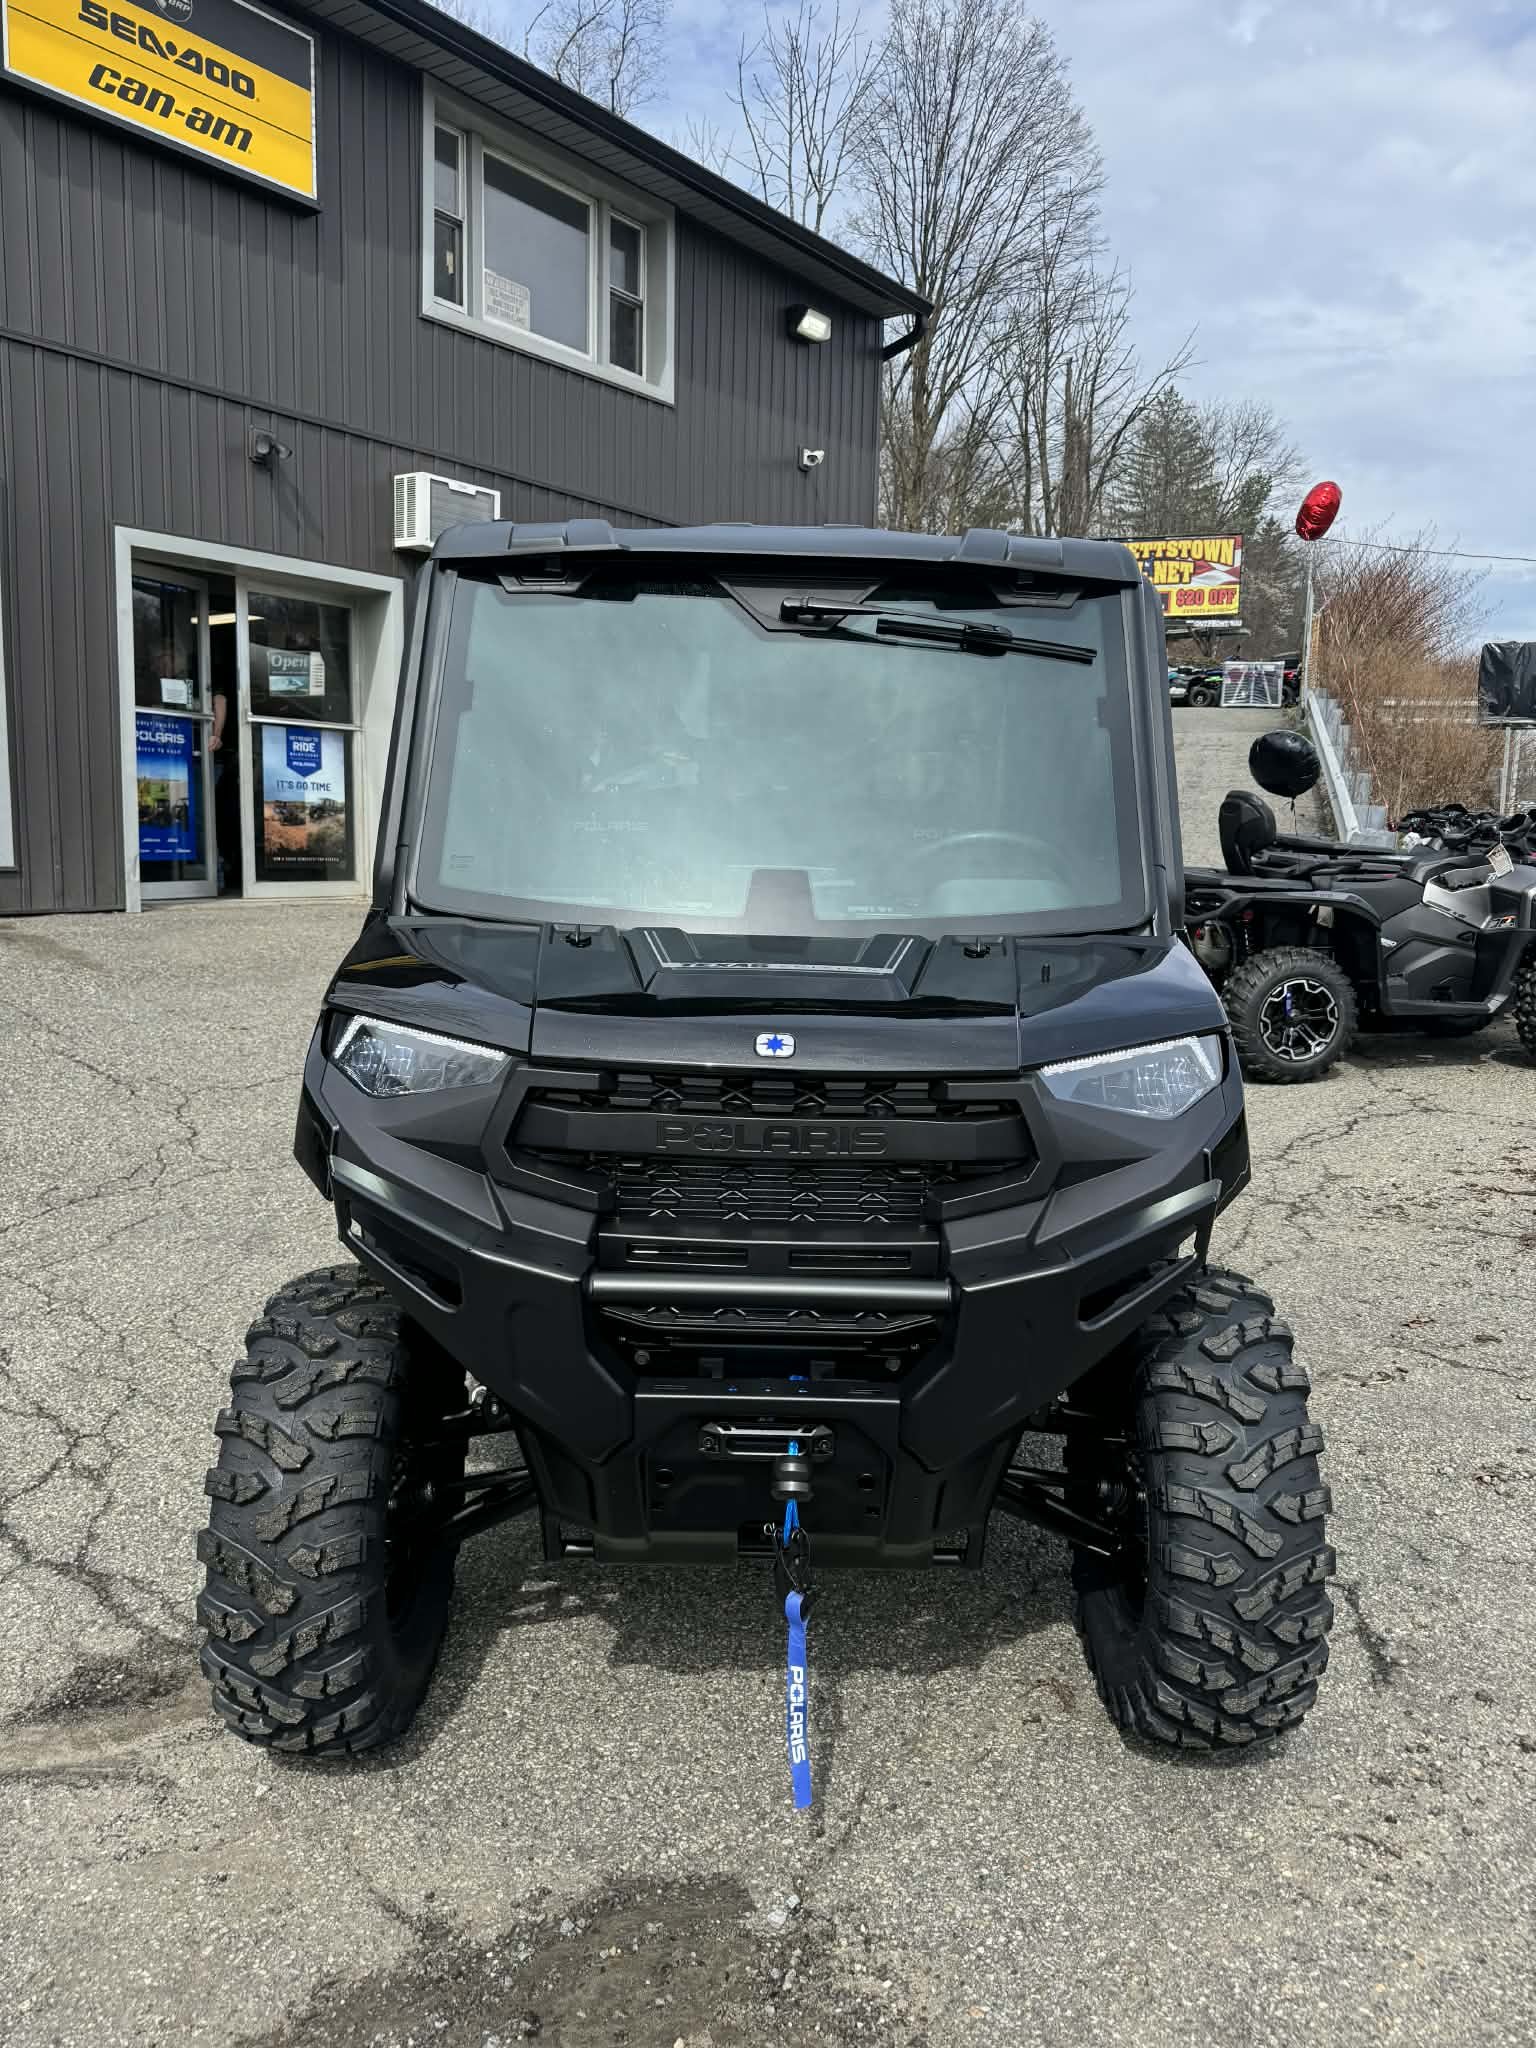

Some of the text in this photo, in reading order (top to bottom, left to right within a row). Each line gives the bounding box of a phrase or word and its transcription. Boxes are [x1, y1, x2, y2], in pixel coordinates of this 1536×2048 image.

[1176, 588, 1237, 607] $20 OFF
[271, 655, 309, 671] Open
[136, 730, 185, 744] OLARIS
[292, 741, 316, 753] RIDE
[310, 781, 333, 792] TIME
[655, 1120, 889, 1155] POLARIS
[790, 1665, 806, 1764] POLARIS
